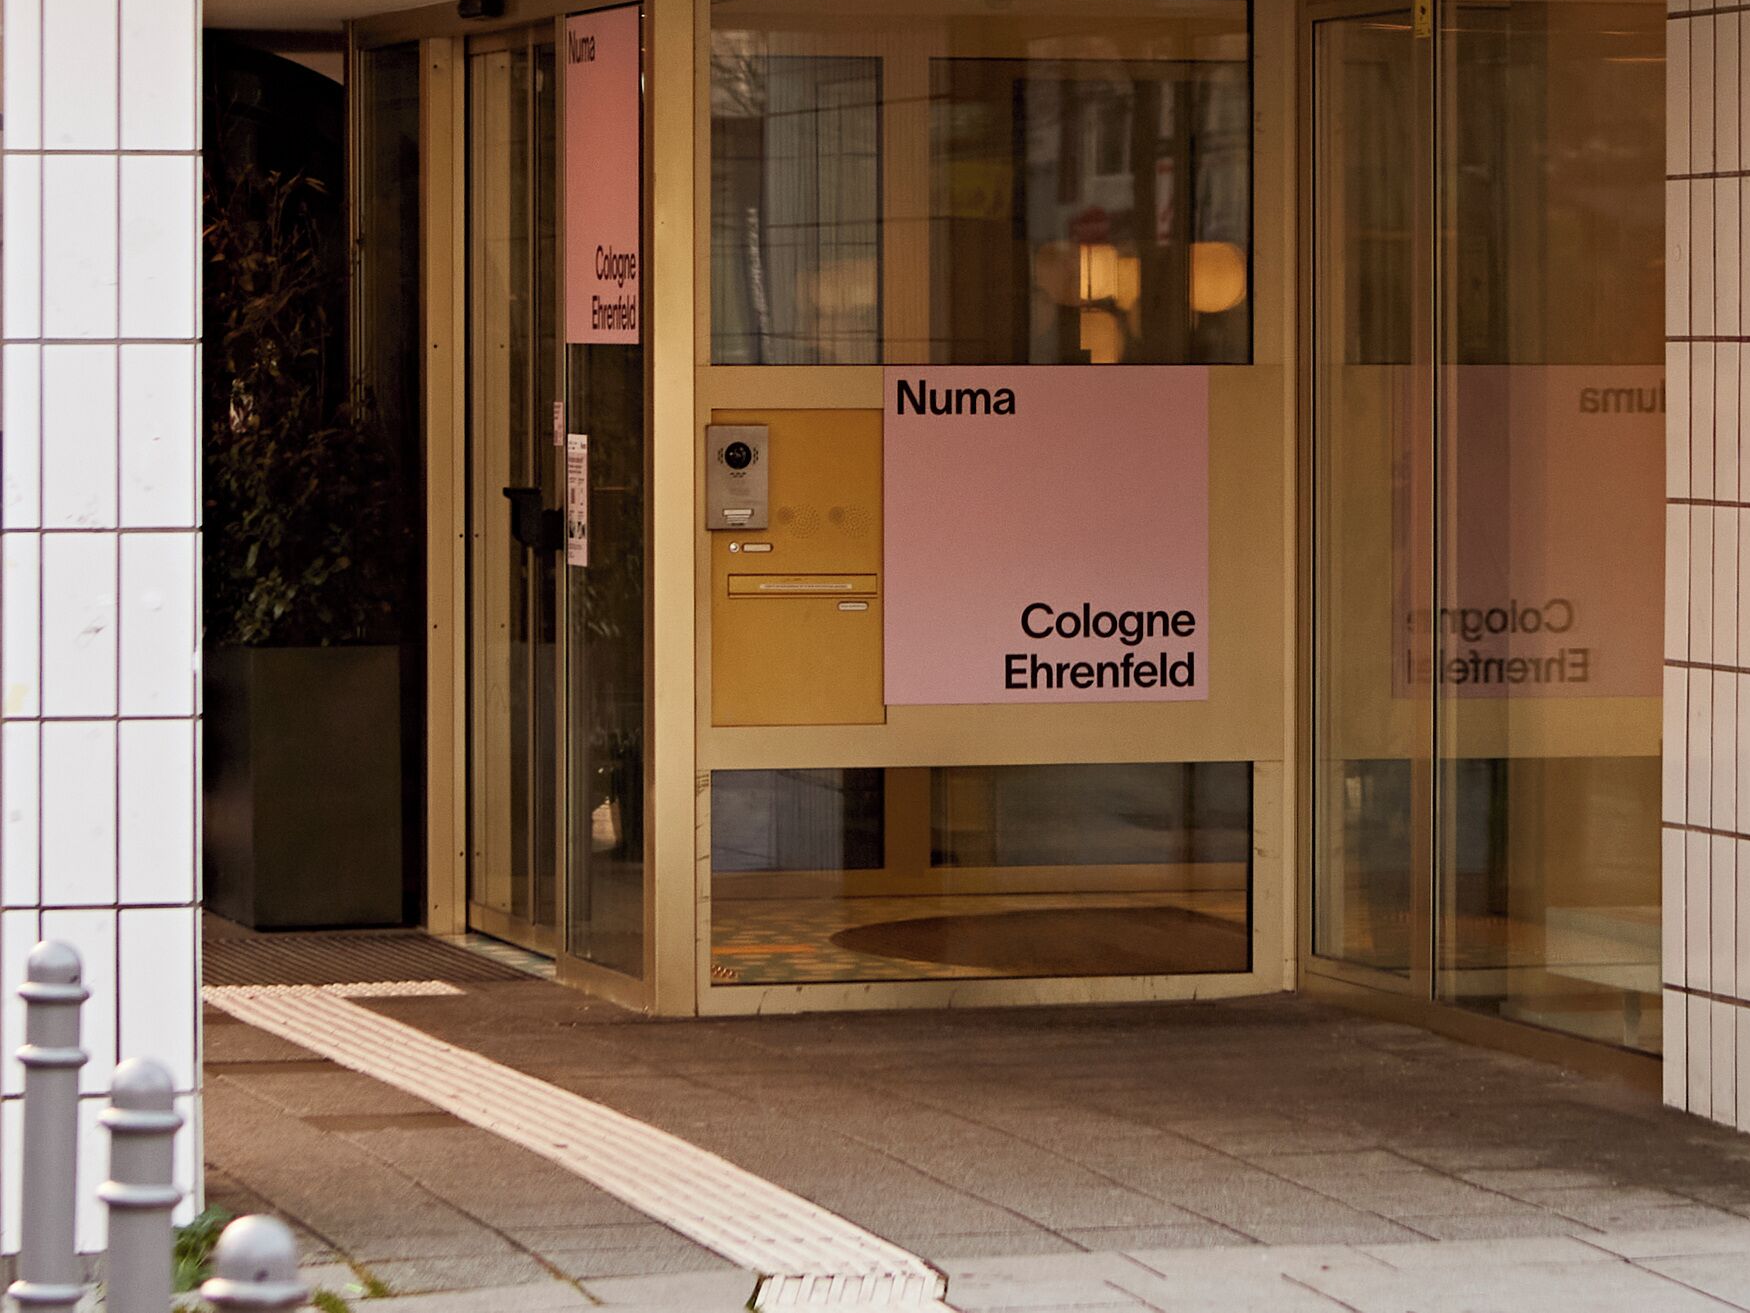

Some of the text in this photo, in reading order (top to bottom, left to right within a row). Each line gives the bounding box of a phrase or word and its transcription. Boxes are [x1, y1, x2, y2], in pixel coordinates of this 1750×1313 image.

[568, 29, 596, 64] Numa
[595, 245, 636, 288] Cologne
[592, 295, 636, 330] Ehrenfeld
[897, 379, 1016, 416] Numa
[1021, 602, 1196, 647] Cologne
[1005, 652, 1195, 689] Ehrenfeld
